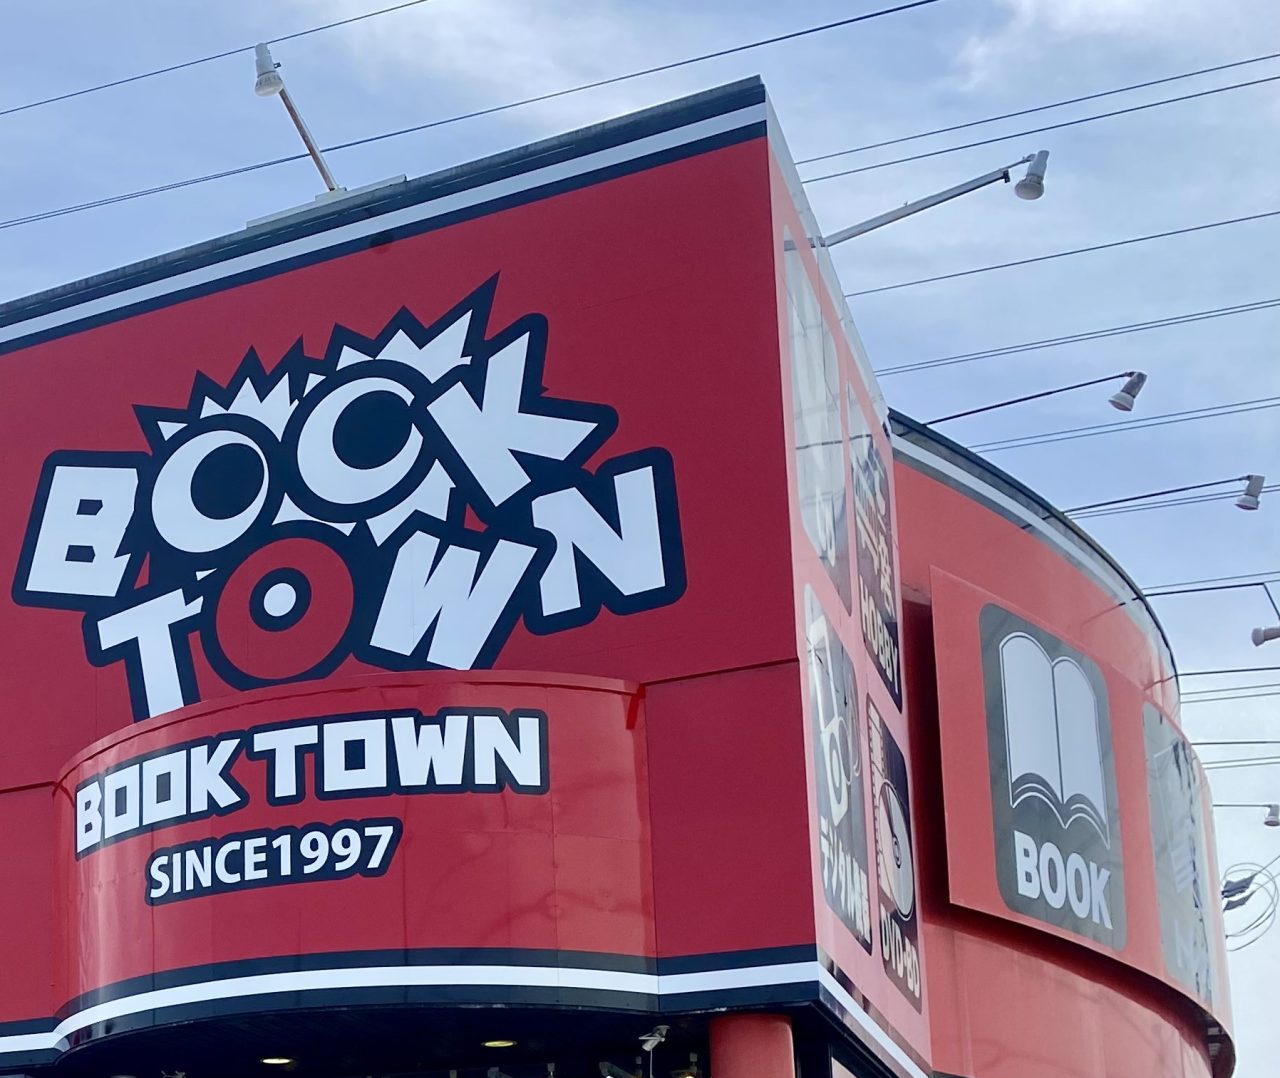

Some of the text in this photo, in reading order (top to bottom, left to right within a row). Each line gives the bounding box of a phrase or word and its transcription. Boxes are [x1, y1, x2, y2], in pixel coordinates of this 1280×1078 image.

[20, 322, 608, 602] BOOK
[92, 460, 675, 720] TOWN
[859, 574, 899, 695] HOBBY
[76, 714, 542, 855] BOOK TOWN
[1013, 829, 1113, 930] BOOK
